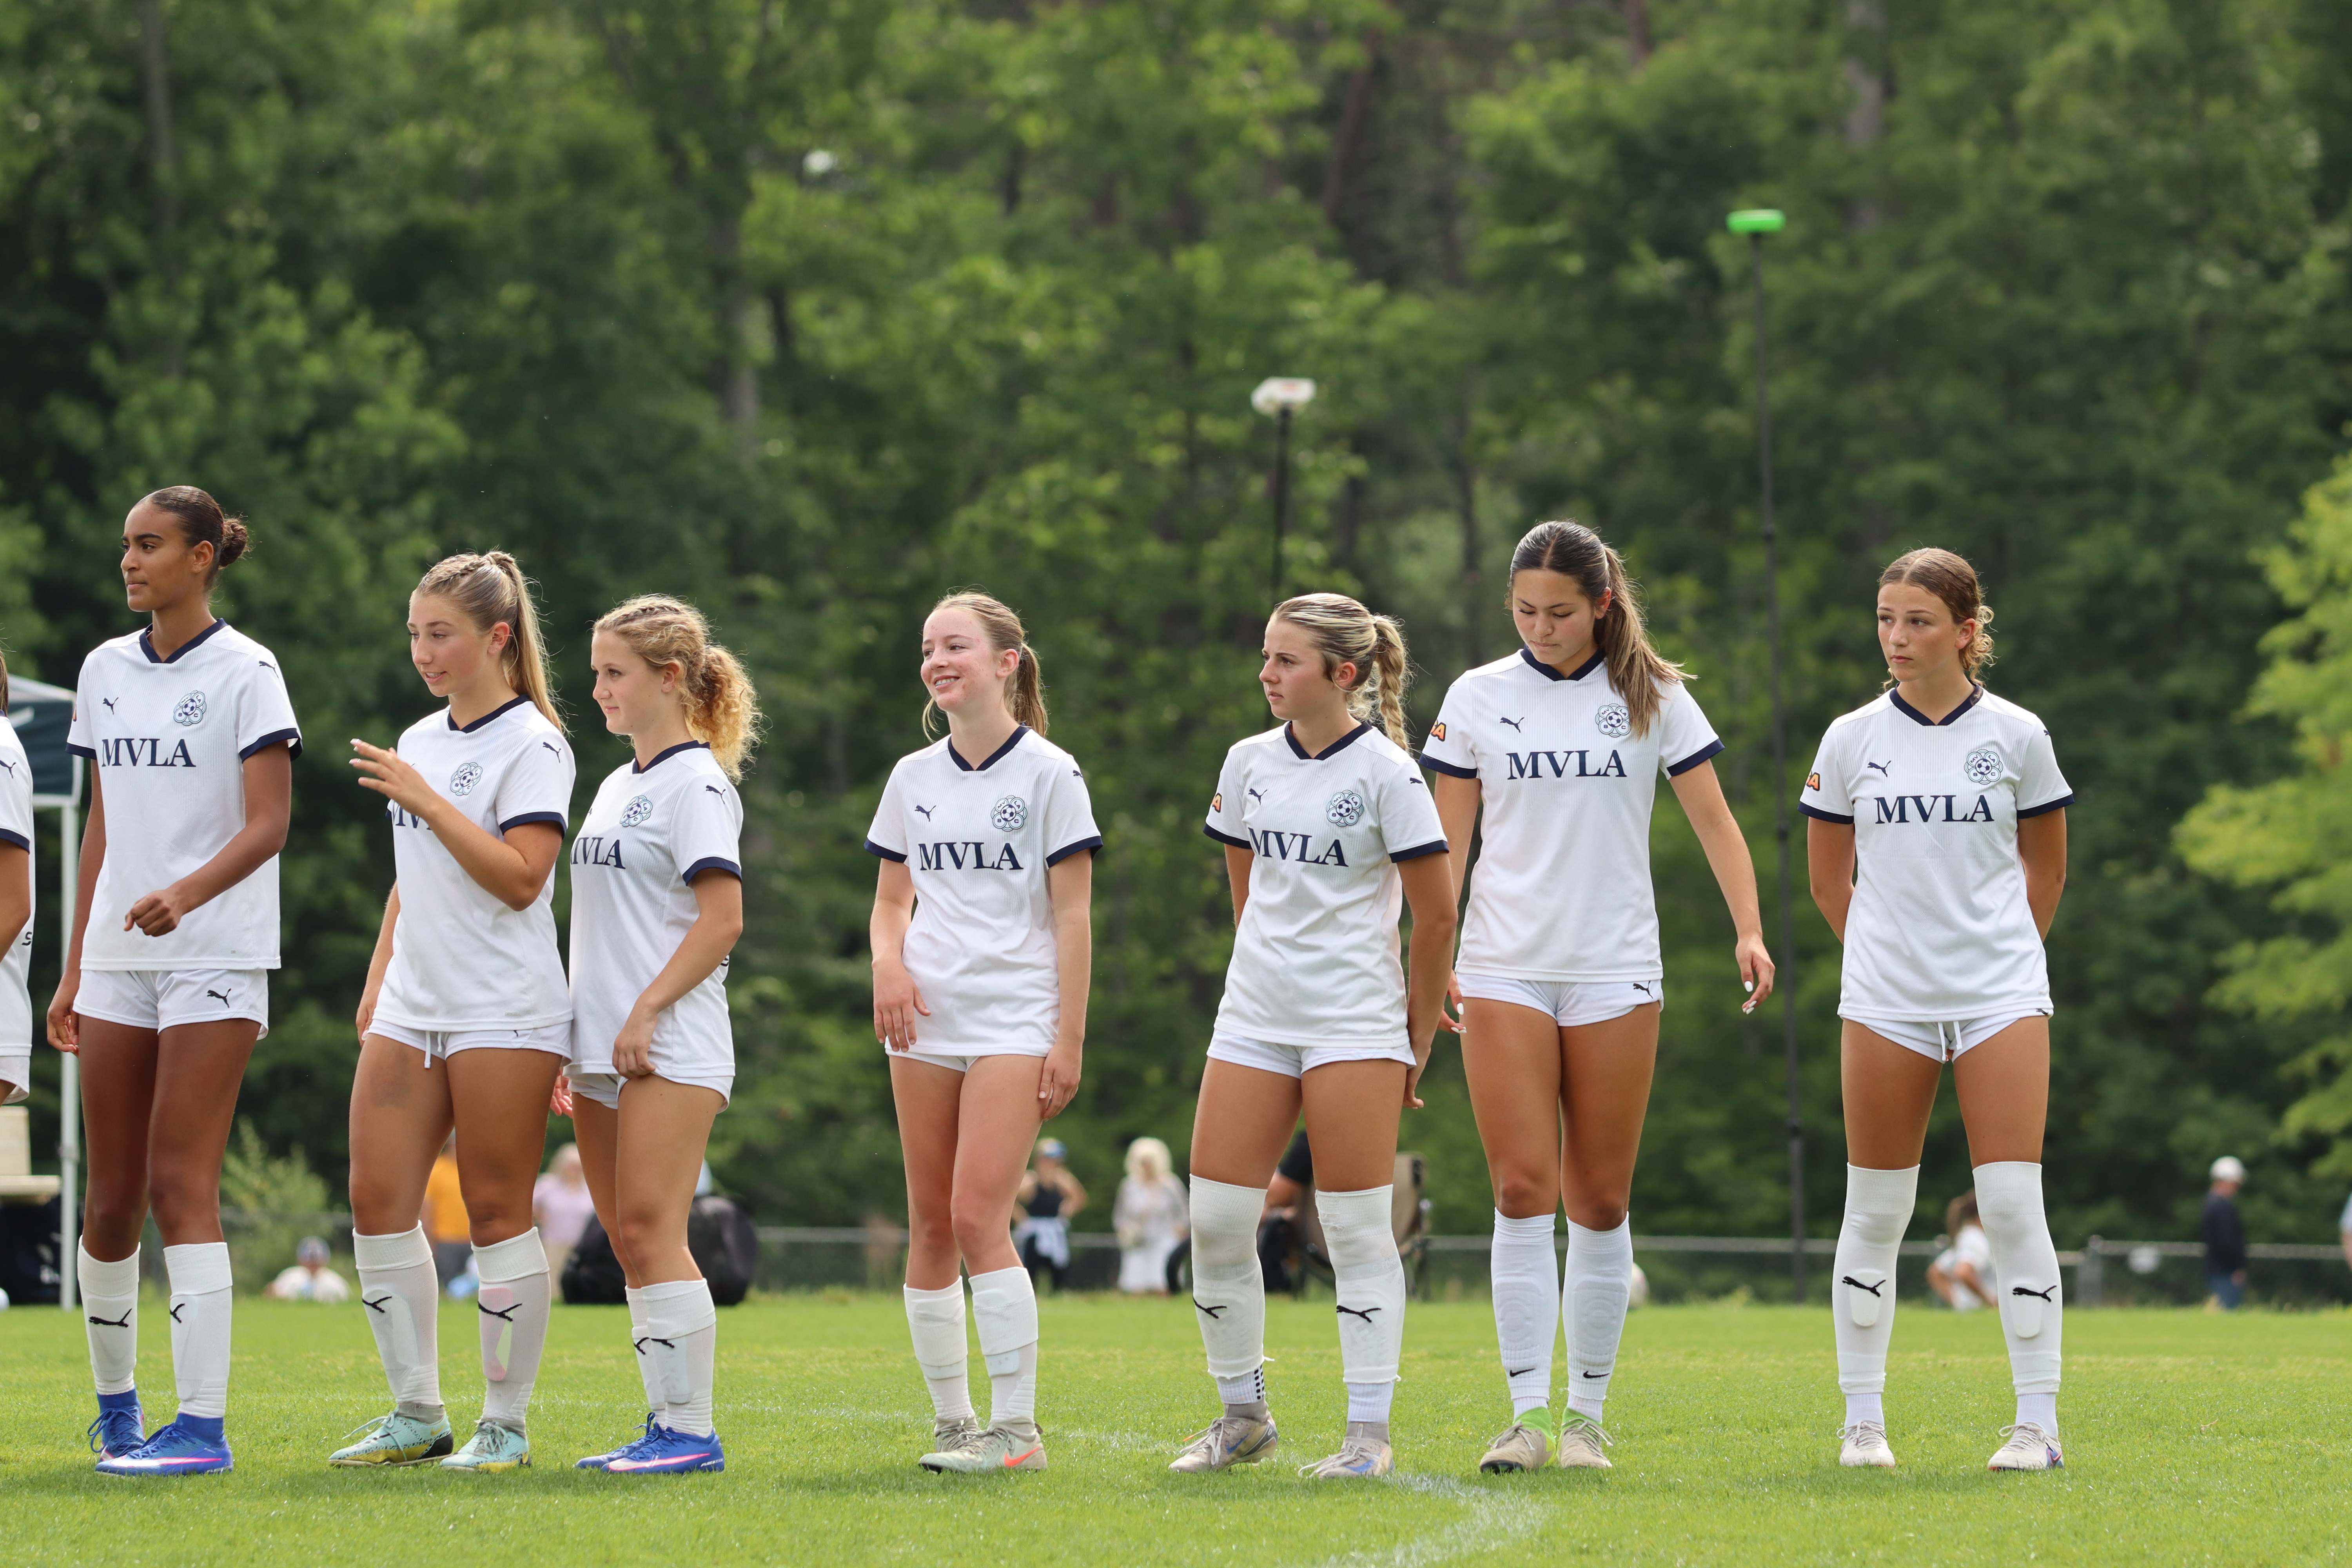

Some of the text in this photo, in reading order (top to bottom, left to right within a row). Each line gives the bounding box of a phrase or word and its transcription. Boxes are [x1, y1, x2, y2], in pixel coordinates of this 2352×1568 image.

[1619, 709, 1627, 717] LA
[102, 739, 196, 767] MVLA
[1506, 750, 1627, 780] MVLA
[1970, 754, 1996, 763] MV LA
[998, 800, 1020, 809] MV LA
[1333, 795, 1358, 806] MV LA
[1874, 795, 1995, 824] MVLA
[918, 842, 1024, 871] MVLA
[1248, 828, 1348, 867] MVLA
